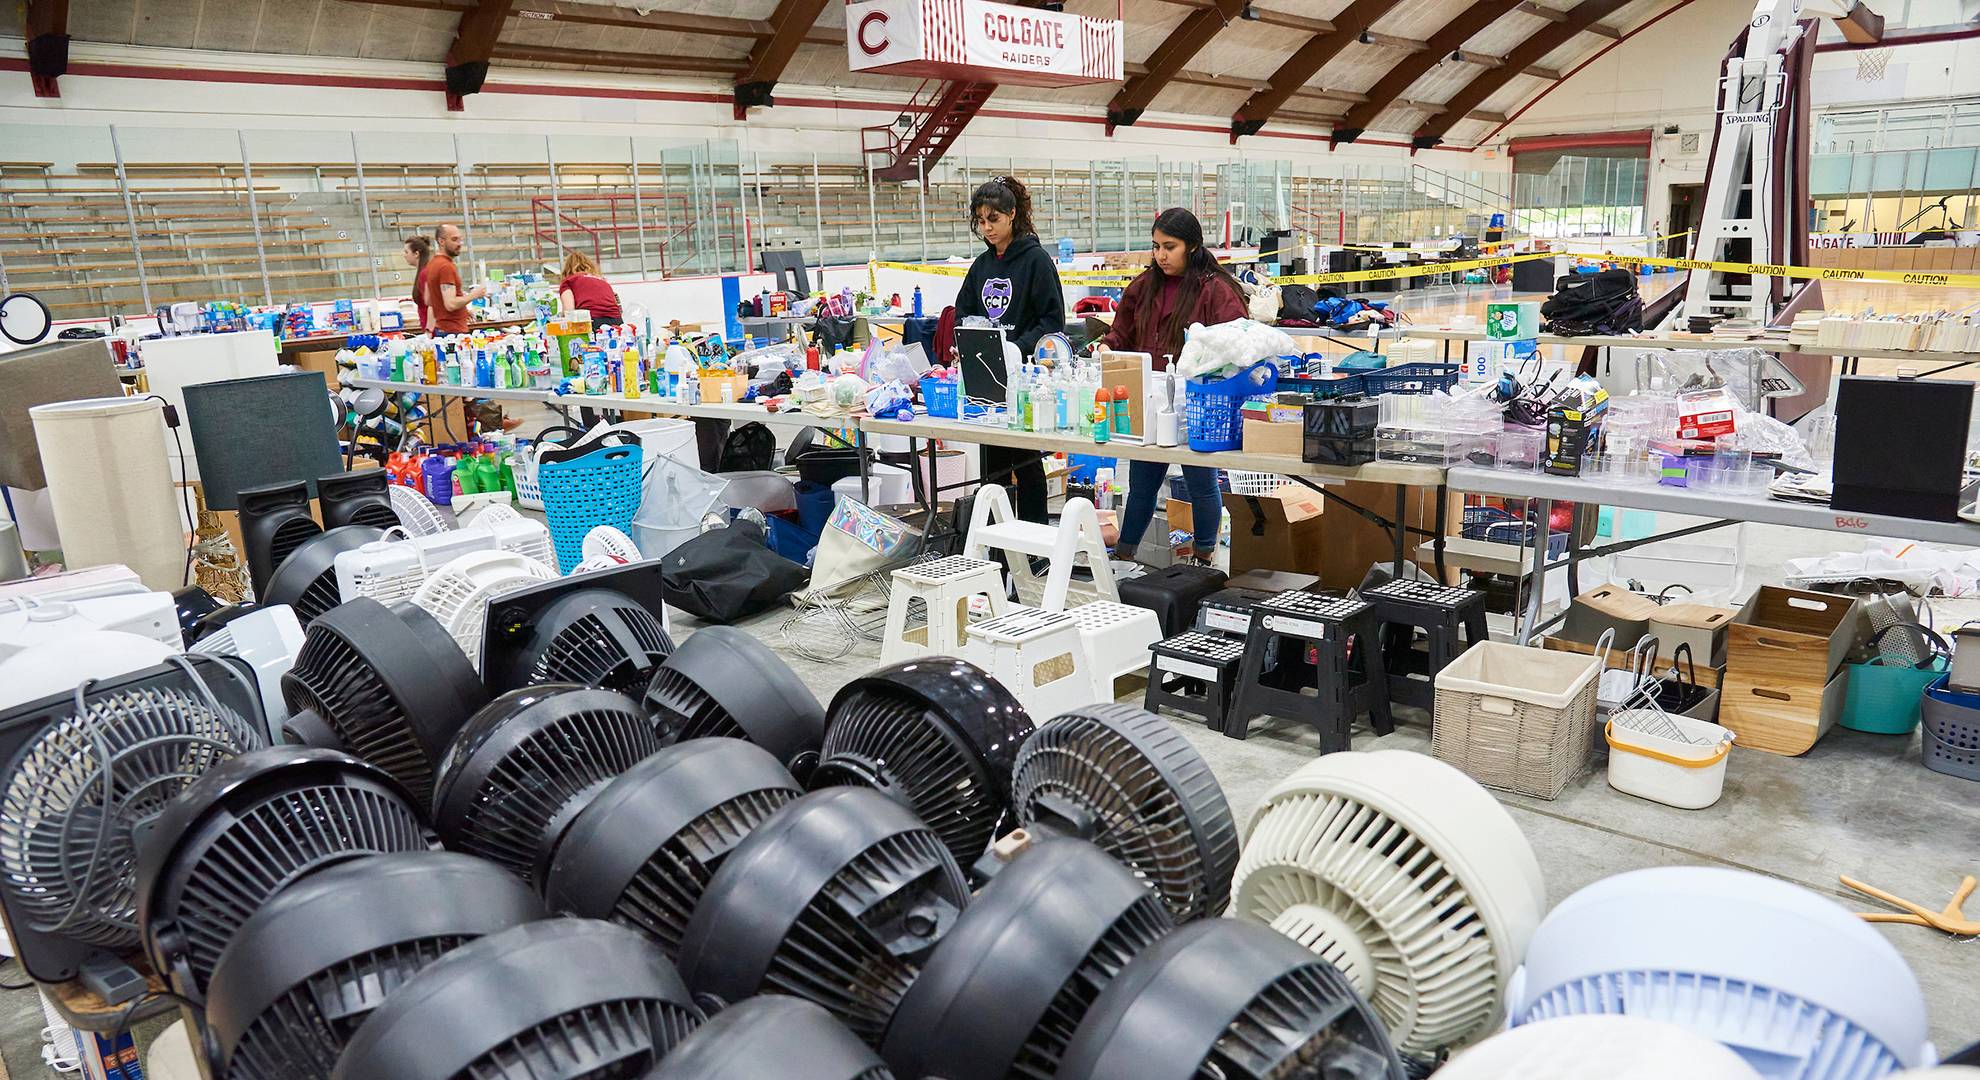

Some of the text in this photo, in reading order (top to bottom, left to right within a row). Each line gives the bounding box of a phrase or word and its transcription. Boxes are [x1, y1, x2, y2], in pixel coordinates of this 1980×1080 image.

[857, 10, 890, 57] C
[984, 12, 1064, 49] COLGATE
[1002, 51, 1051, 66] RAIDERS
[1726, 113, 1769, 125] SPALDING
[1478, 258, 1509, 268] CAUTION
[1675, 260, 1712, 270] CAUTION
[1369, 270, 1396, 279] CAUTION
[1421, 264, 1451, 274] CAUTION
[1746, 264, 1786, 276] CAUTION
[1822, 269, 1864, 279] CAUTION
[1318, 274, 1344, 282] CAUTION
[1903, 274, 1948, 285] CAUTION
[985, 296, 1009, 309] GCP
[1477, 356, 1486, 376] 100
